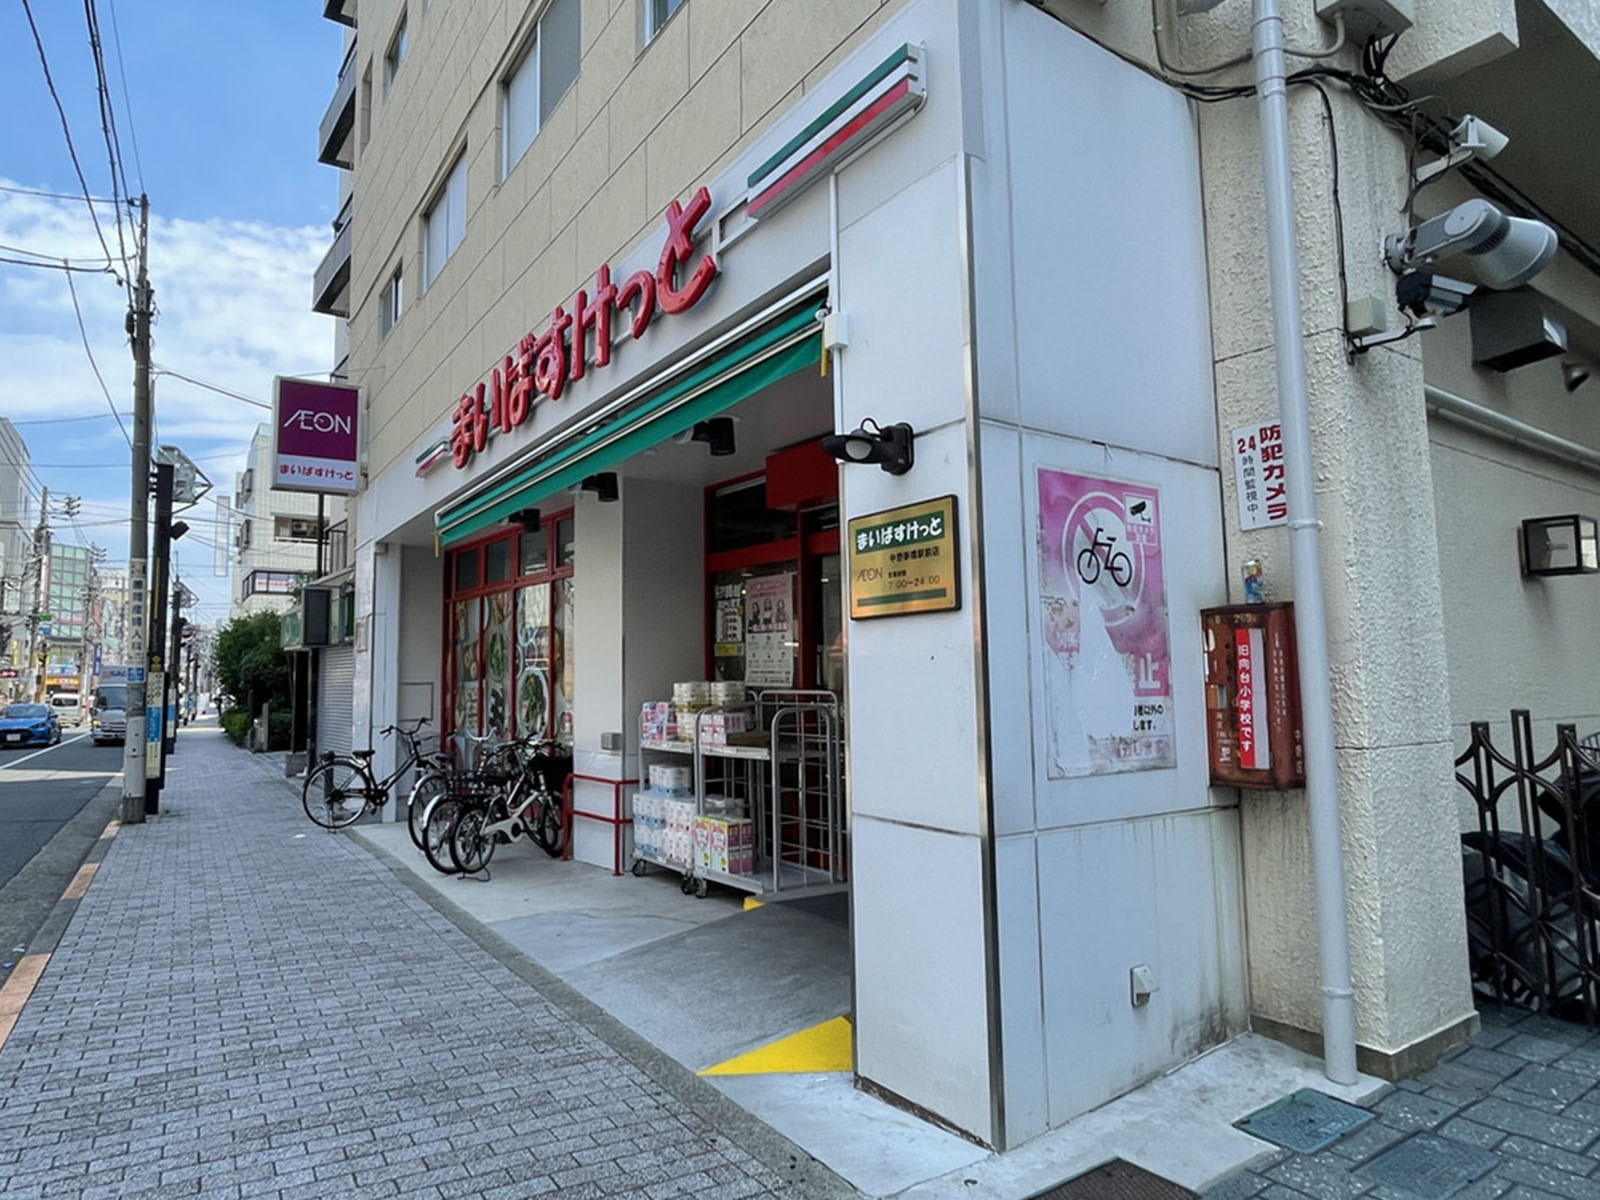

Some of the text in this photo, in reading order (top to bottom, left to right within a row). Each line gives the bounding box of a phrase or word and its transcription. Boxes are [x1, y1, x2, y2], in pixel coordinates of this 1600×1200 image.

[452, 186, 717, 469] まいばすけっと
[279, 464, 354, 481] まいばすけっと
[1259, 424, 1288, 520] 防犯カメラ
[857, 517, 942, 550] まいばすけっと
[1139, 652, 1161, 689] 止
[1238, 644, 1252, 752] 旧向台小学校です
